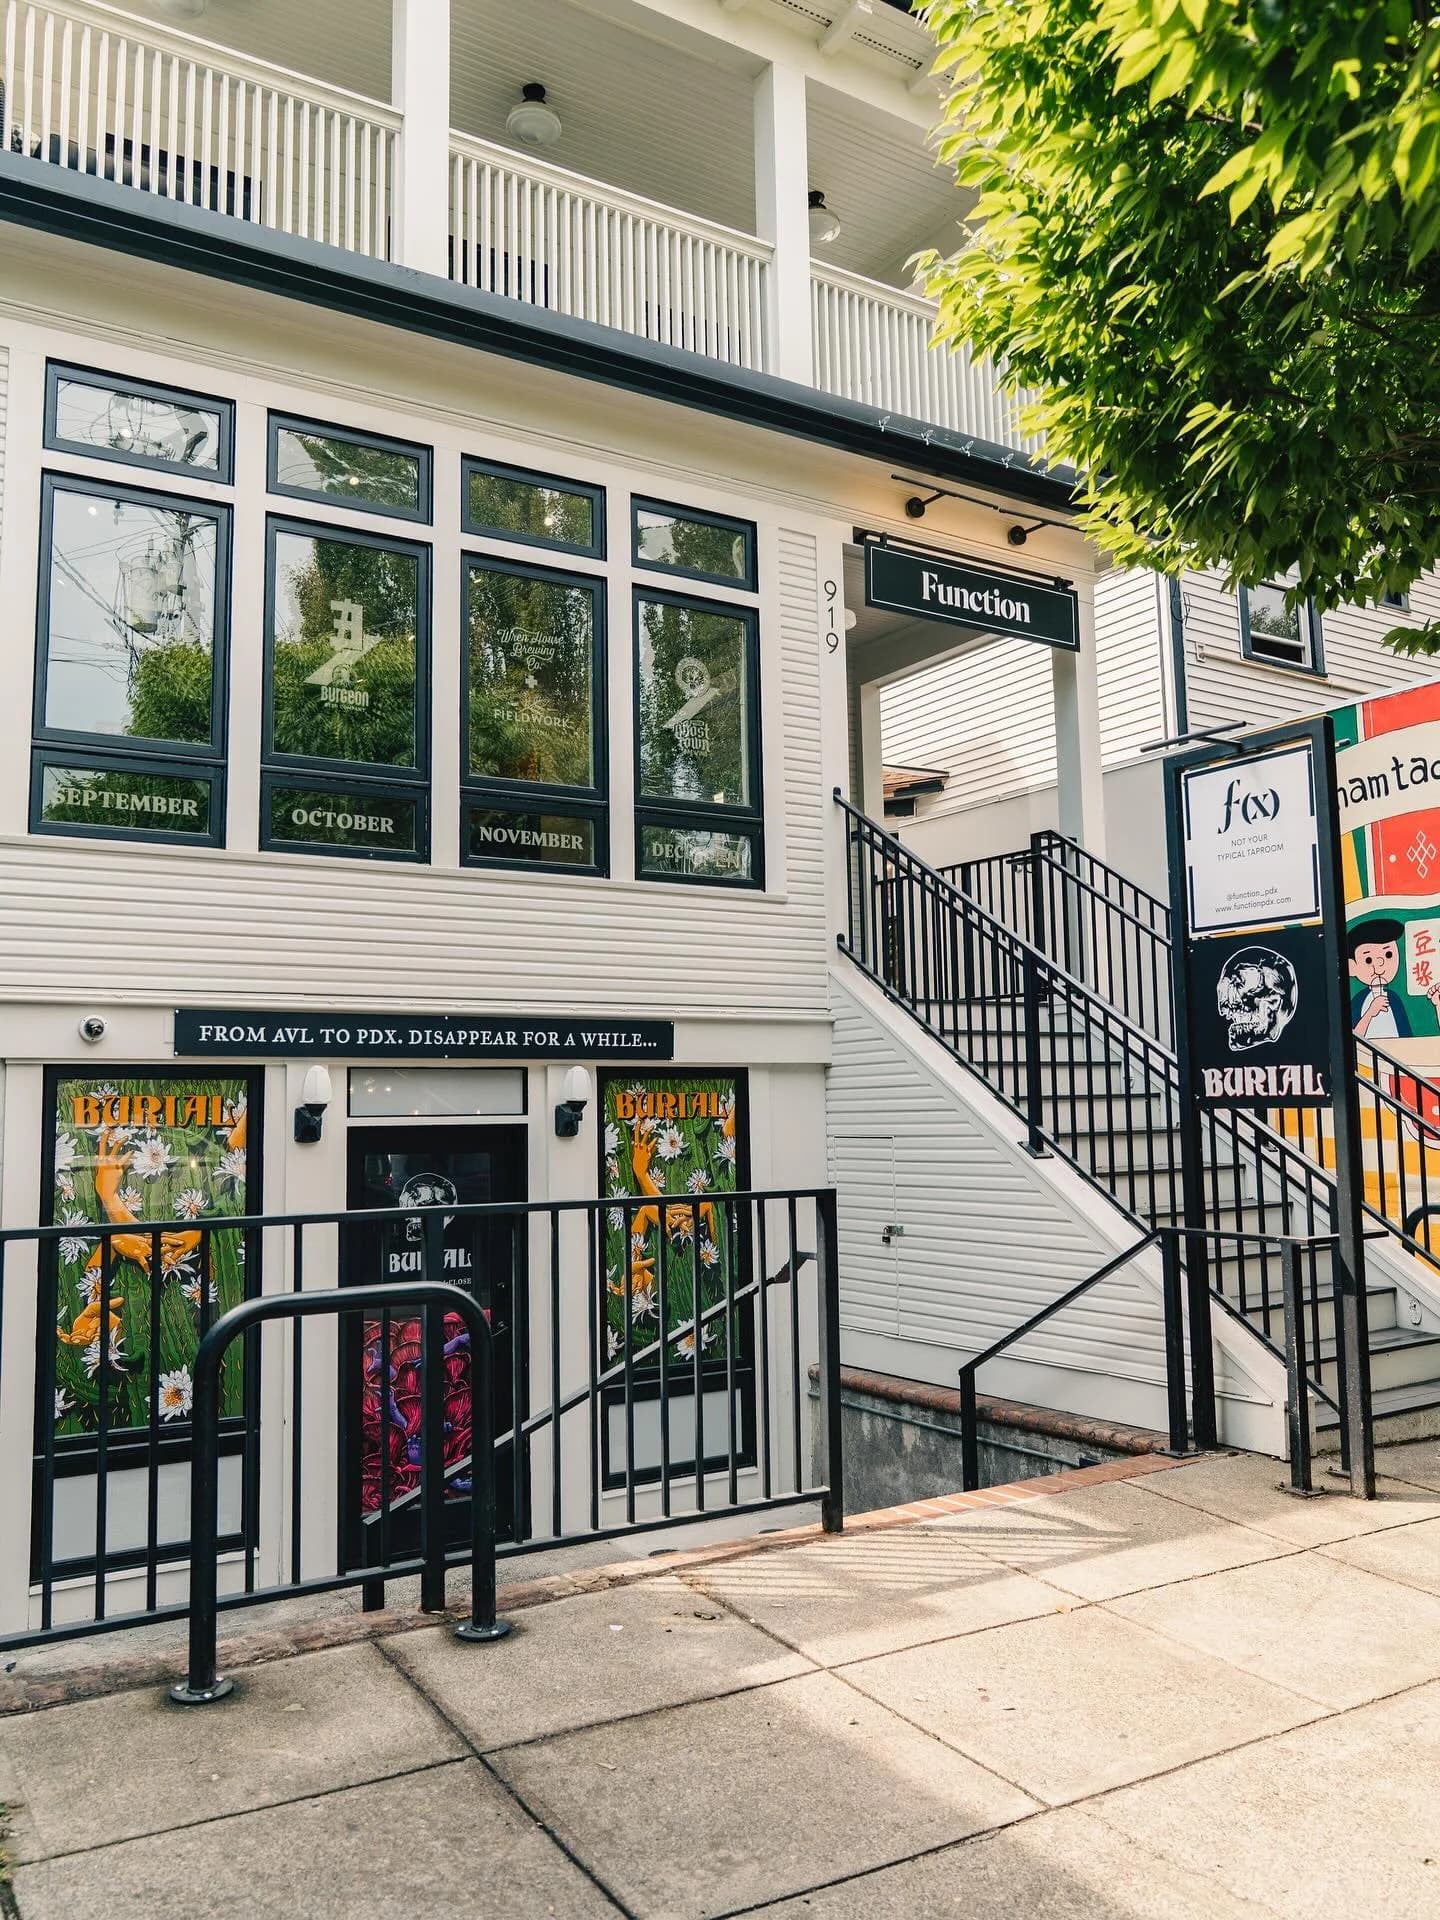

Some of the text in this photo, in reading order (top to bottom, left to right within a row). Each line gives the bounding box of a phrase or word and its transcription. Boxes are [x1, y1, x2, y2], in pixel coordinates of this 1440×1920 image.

[921, 570, 1032, 624] Function
[823, 580, 839, 654] 919
[510, 642, 556, 661] Brewing
[54, 788, 199, 817] SEPTEMBER
[1217, 779, 1280, 834] f(x)
[291, 809, 396, 834] OCTOBER
[479, 826, 584, 850] NOVEMBER
[1231, 834, 1268, 847] NOT YOUR
[1217, 844, 1284, 862] TYPICAL TAPROOM
[1215, 896, 1292, 913] www.functionpdx.com
[1226, 886, 1279, 901] @function_pdx
[199, 1025, 657, 1048] FROM AVL TO PDX. DISAPPEAR FOR A WHILE...
[1201, 1064, 1325, 1098] BURIAL
[70, 1094, 238, 1129] BURIAL
[615, 1090, 729, 1120] BURIAL
[389, 1248, 473, 1273] BUAL
